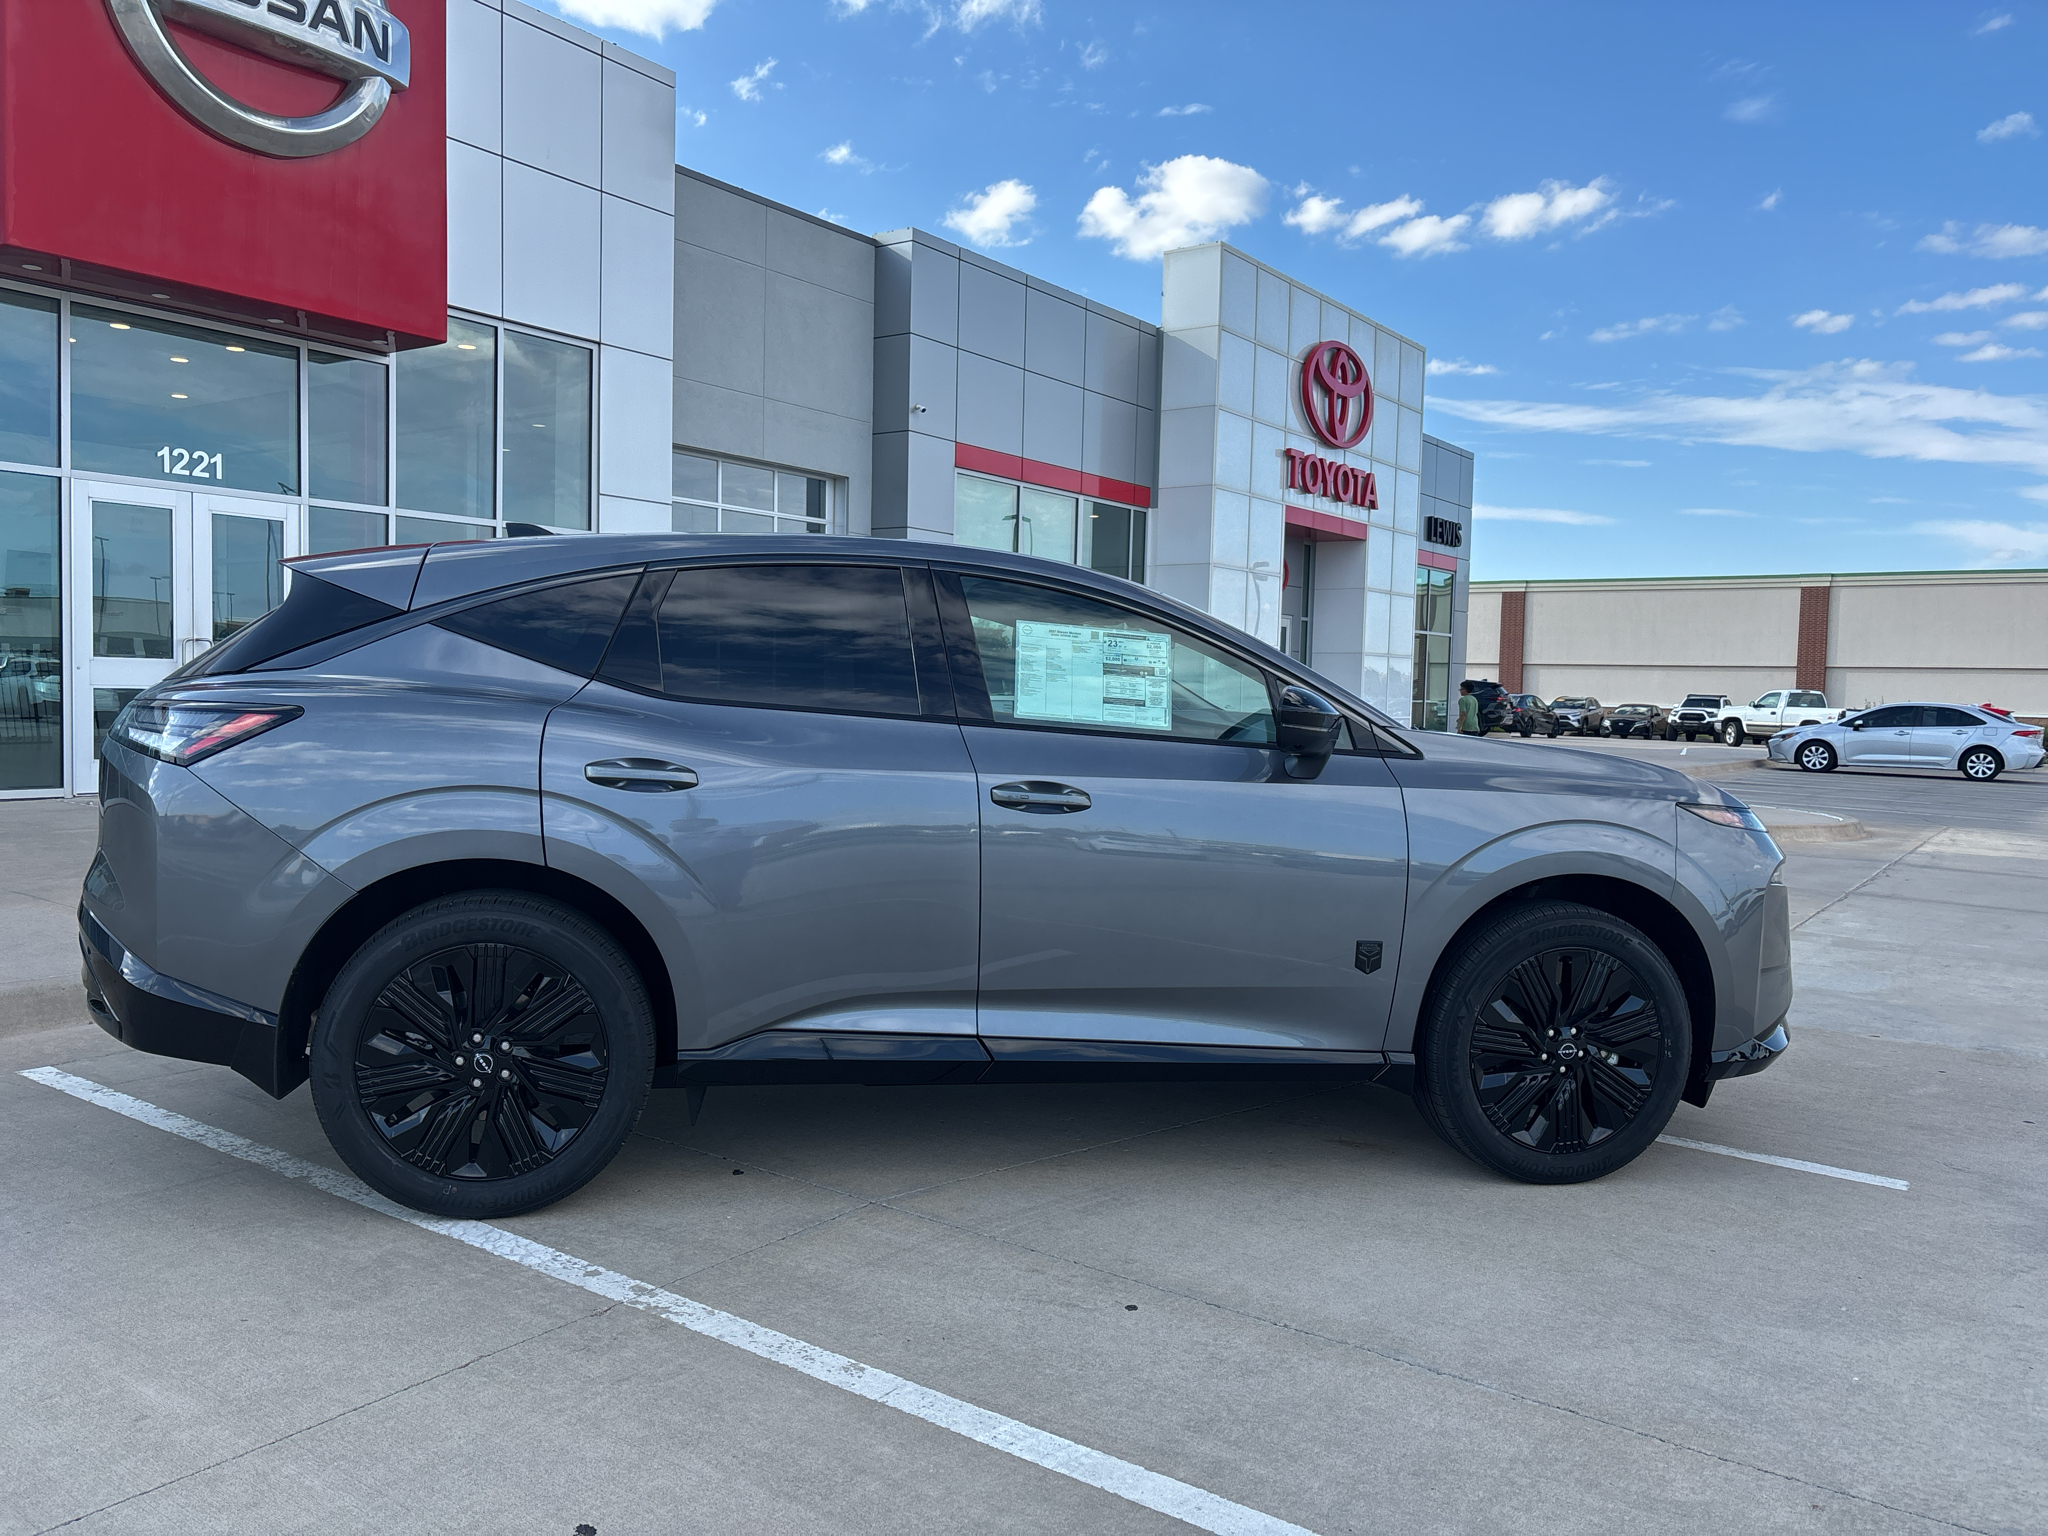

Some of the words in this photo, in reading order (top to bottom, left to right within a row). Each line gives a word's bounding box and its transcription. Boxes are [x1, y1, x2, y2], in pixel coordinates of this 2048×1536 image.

[236, 0, 391, 63] SAN
[157, 446, 223, 480] 1221
[1286, 448, 1379, 510] TOYOTA
[1427, 515, 1462, 547] LEWIS
[1107, 639, 1118, 648] 23
[400, 918, 542, 953] BRIDGESTONE
[1527, 924, 1634, 949] BRIDGESTONE
